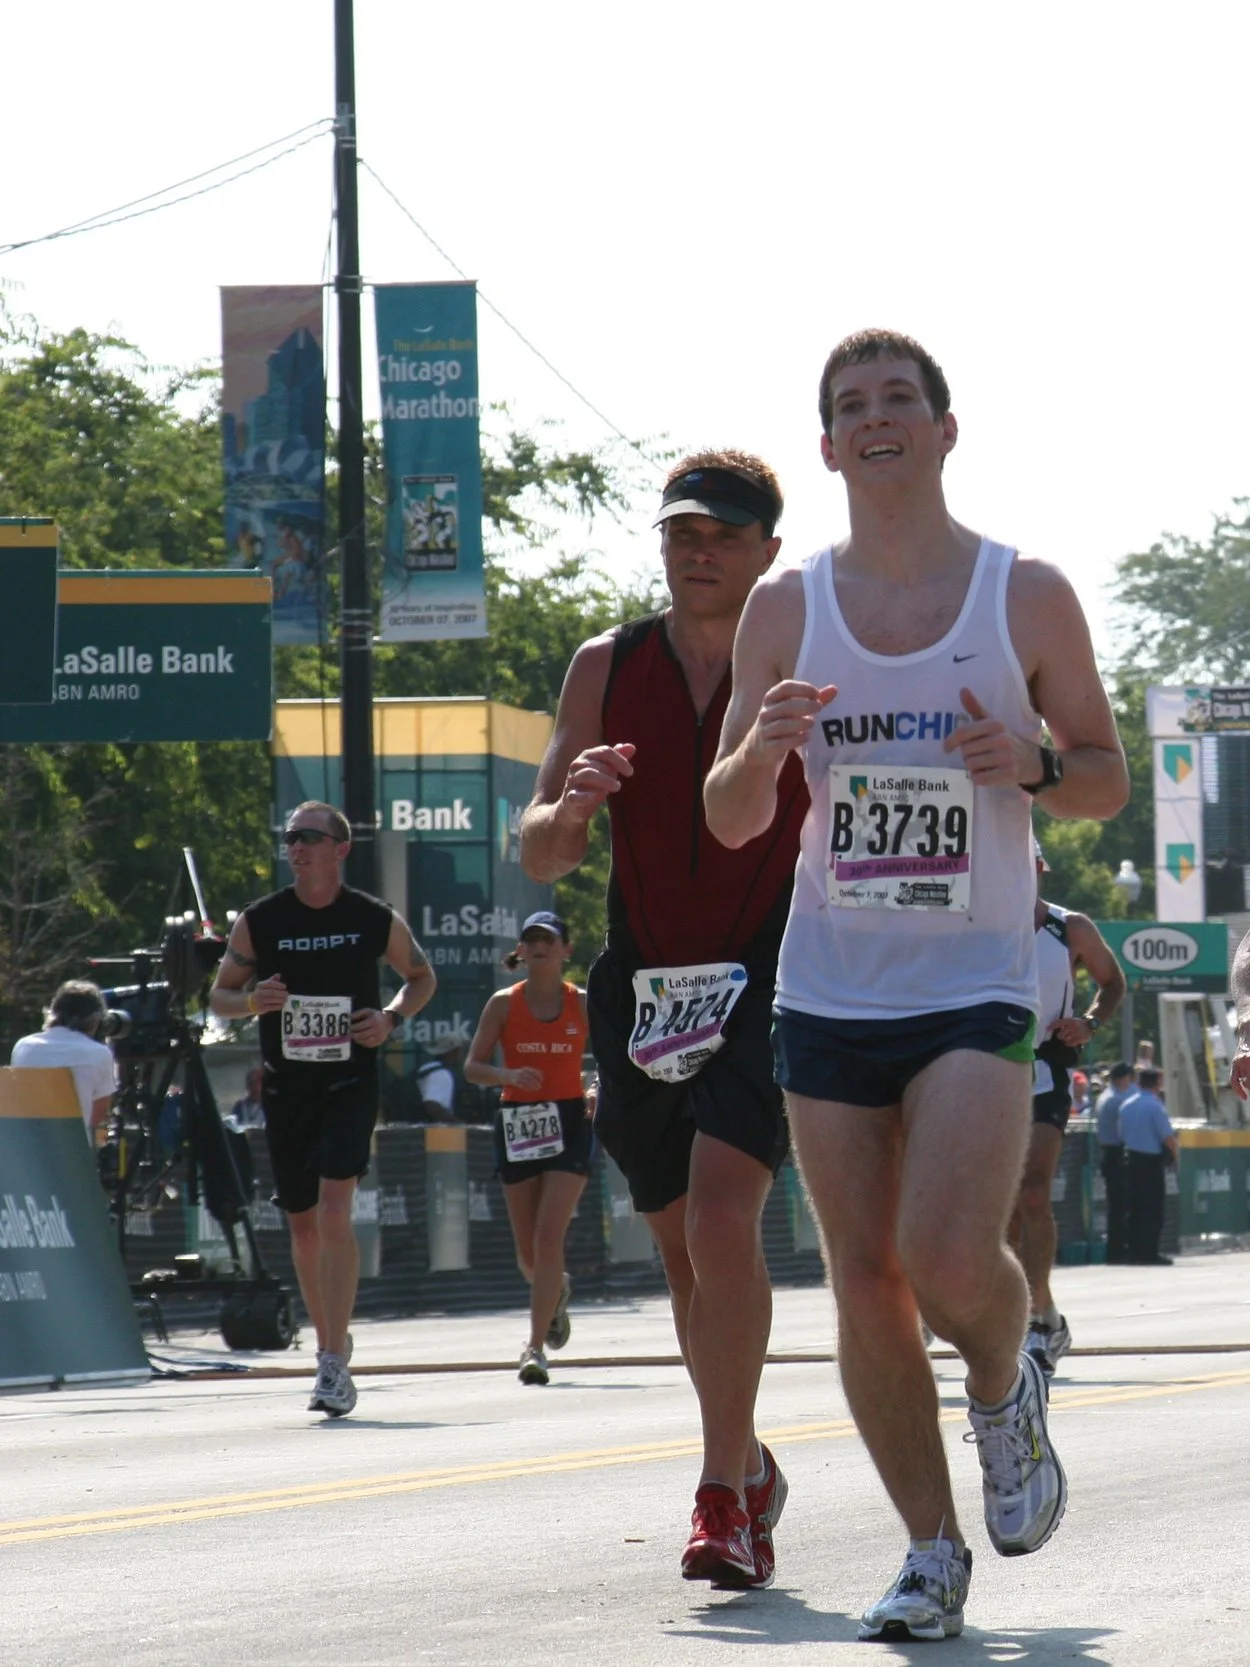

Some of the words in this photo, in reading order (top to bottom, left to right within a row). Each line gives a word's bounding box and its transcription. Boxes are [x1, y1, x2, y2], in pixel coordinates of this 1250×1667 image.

[379, 354, 461, 386] Chicago
[382, 391, 481, 419] Marathon
[389, 614, 434, 627] OCTOBER
[162, 646, 234, 674] Bank
[88, 684, 141, 701] AMRO
[873, 778, 915, 791] LaSalle
[919, 779, 949, 792] Bank
[392, 799, 472, 831] Bank
[831, 802, 854, 852] B
[867, 803, 967, 859] 3739
[874, 860, 960, 875] ANNIVERSARY
[278, 934, 361, 951] ADAPT
[1131, 938, 1188, 960] 100m
[668, 975, 707, 989] LaSalle
[710, 972, 730, 984] Bank
[284, 1012, 293, 1035] B
[300, 1012, 349, 1037] 3386
[632, 1002, 657, 1043] B
[660, 987, 735, 1037] 4574
[516, 1043, 547, 1053] COSTA
[551, 1043, 573, 1053] RICA
[506, 1122, 516, 1141] B
[521, 1115, 560, 1139] 4278
[24, 1194, 76, 1248] Bank
